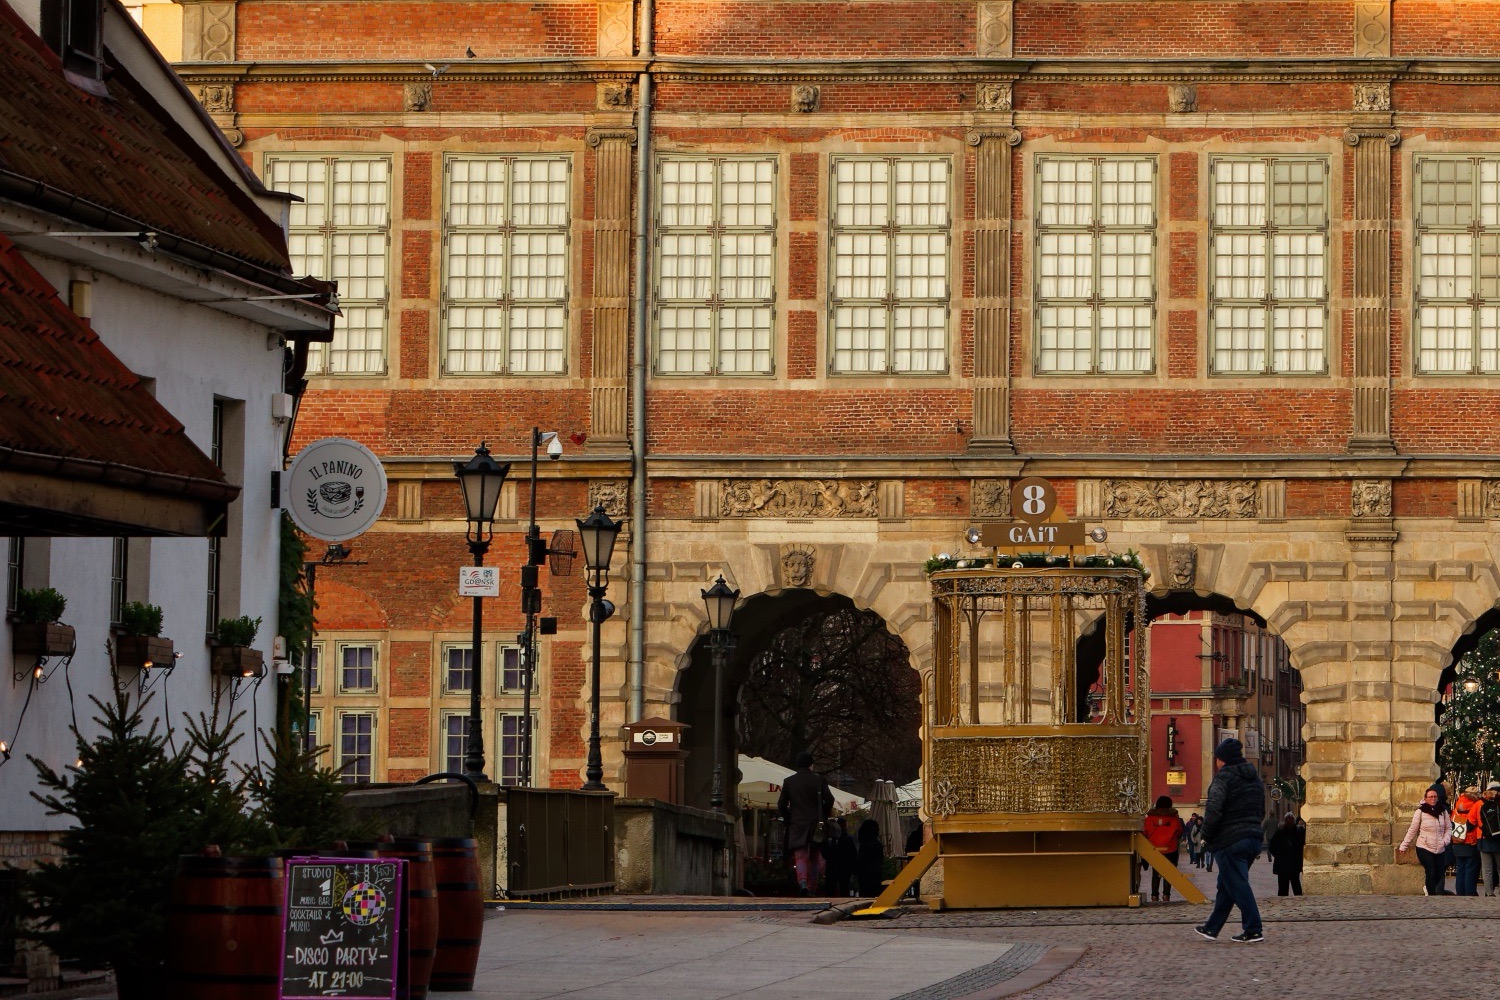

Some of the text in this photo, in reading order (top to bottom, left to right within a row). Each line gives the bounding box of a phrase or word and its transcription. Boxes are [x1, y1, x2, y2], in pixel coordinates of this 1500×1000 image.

[308, 460, 363, 480] IL PANINO
[1022, 485, 1046, 515] 8
[1009, 526, 1059, 543] GAiT
[302, 868, 332, 879] STUDIO
[319, 879, 331, 896] 1
[299, 896, 331, 906] MUSIC BAR
[289, 909, 323, 920] COCKTAILS
[289, 921, 311, 932] MUSIC
[295, 946, 378, 966] DISCO PARTY
[308, 970, 364, 989] AT 21:00
